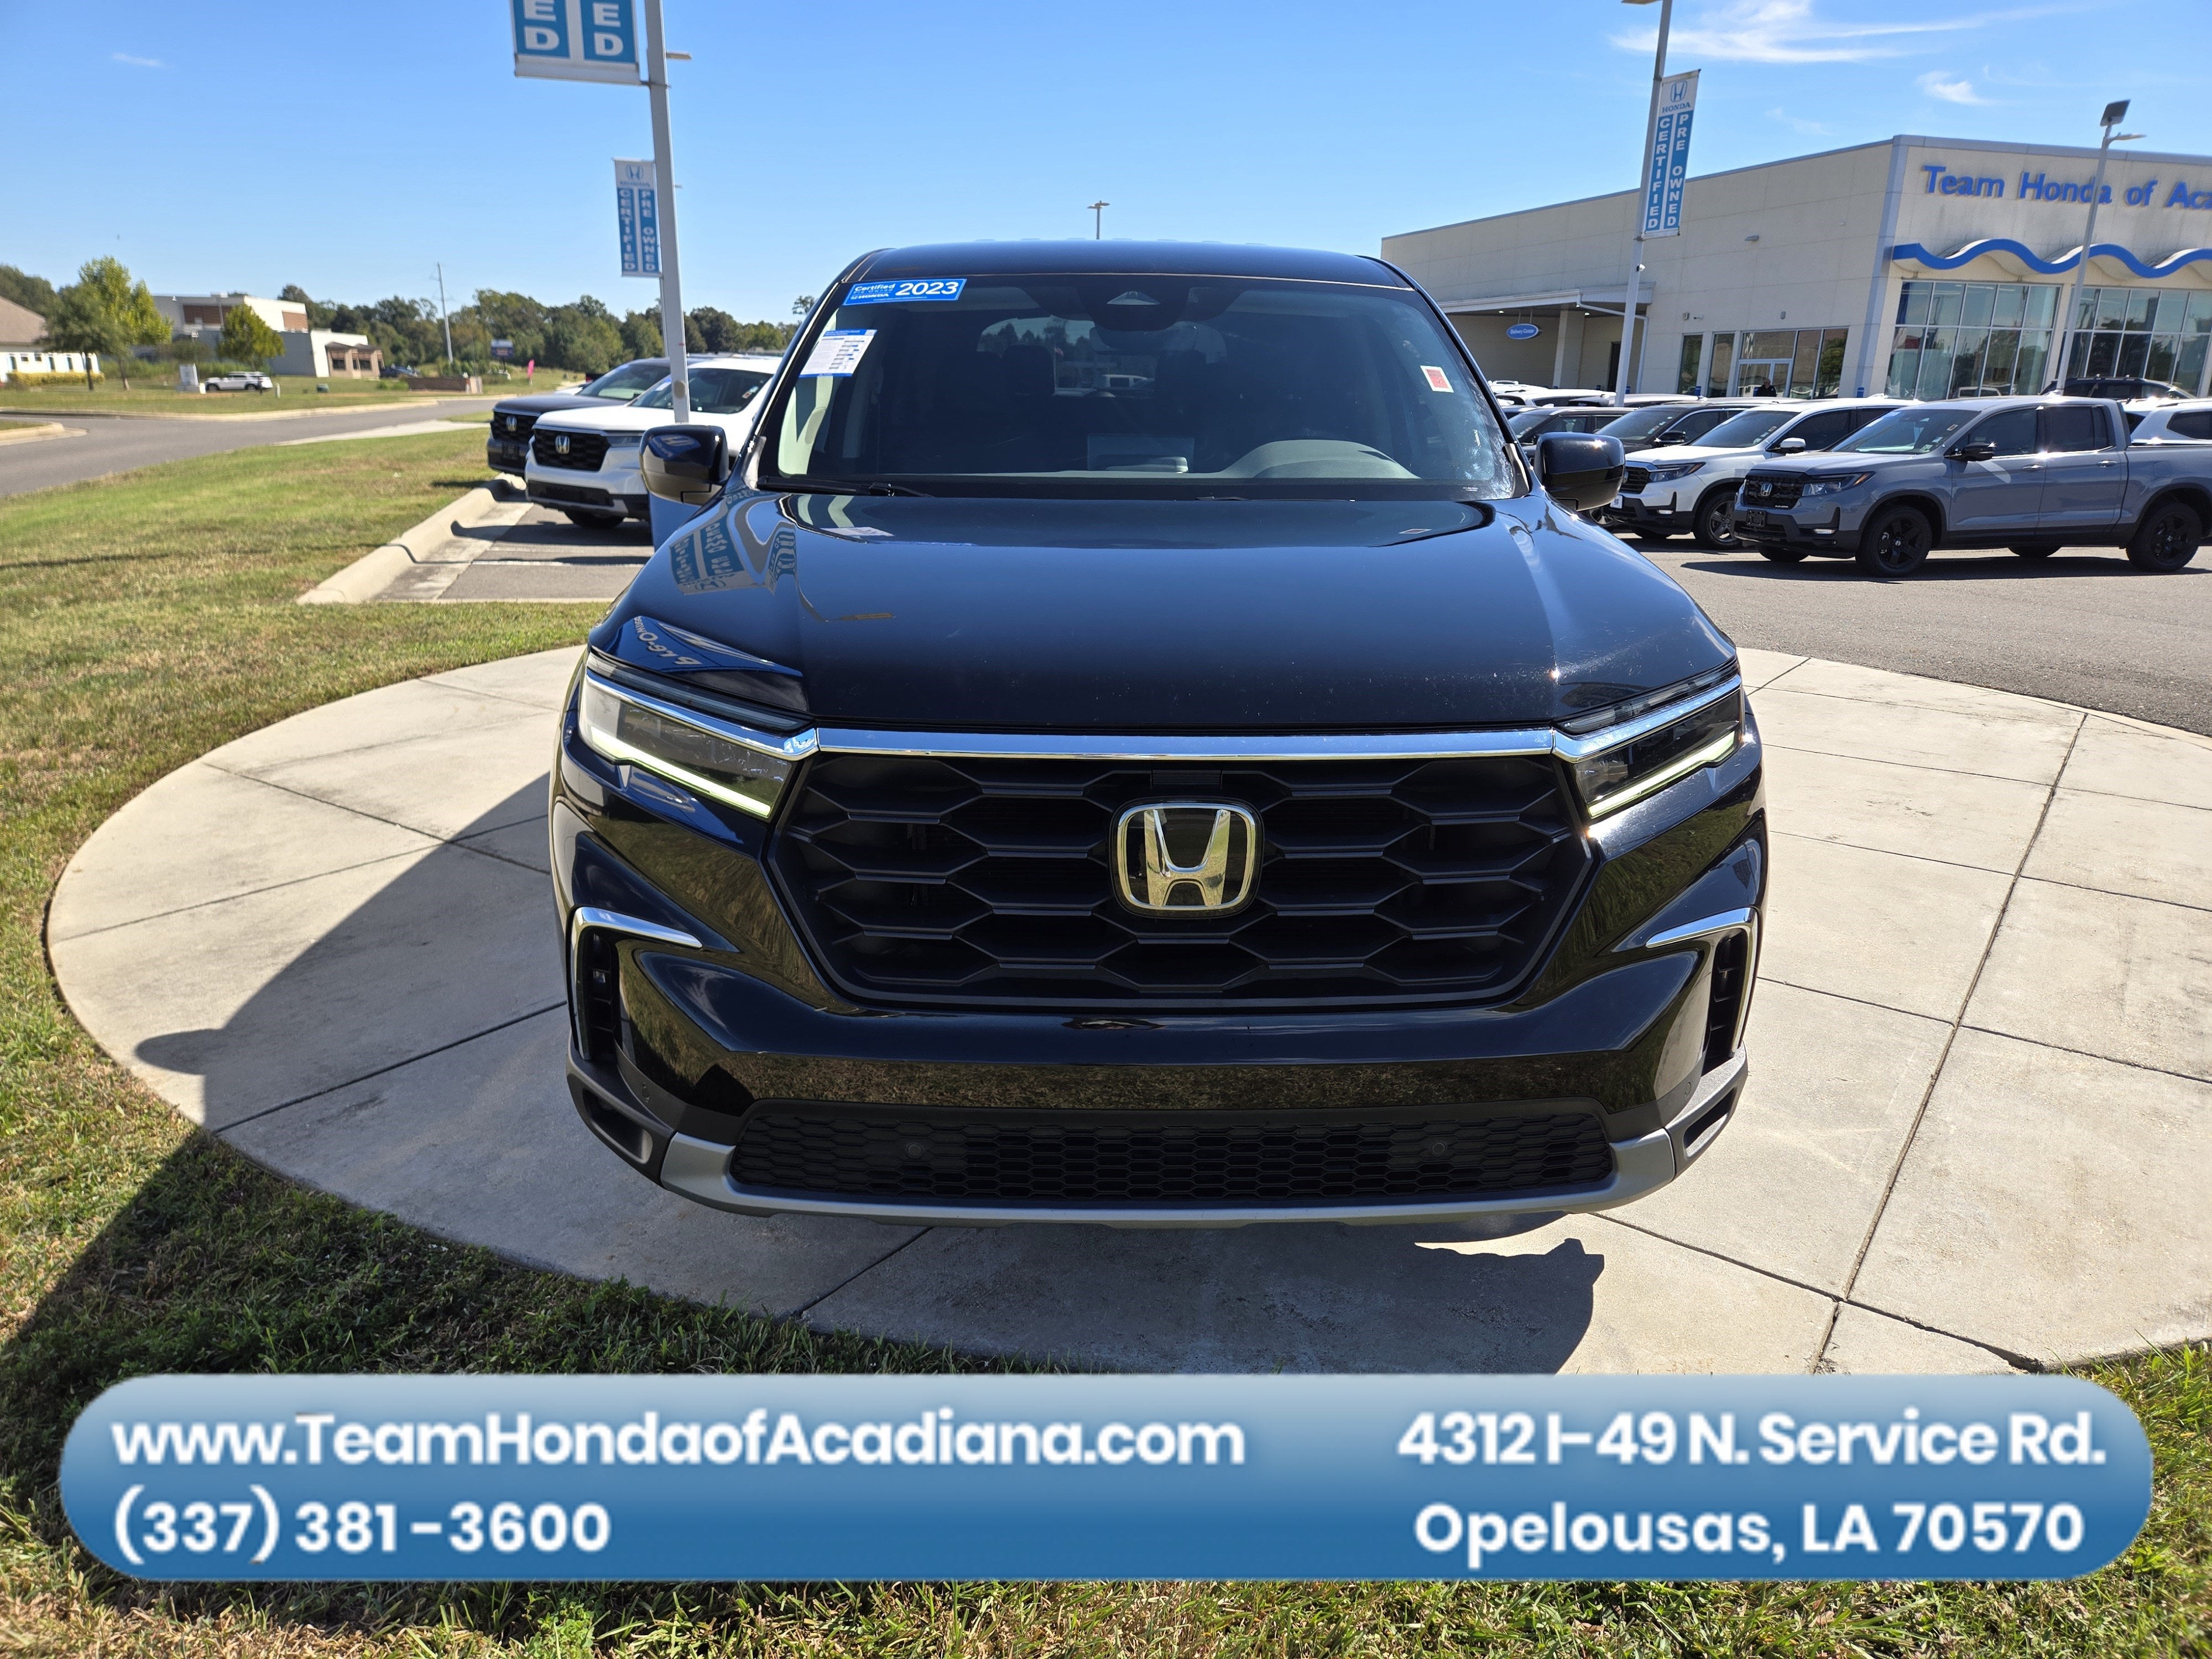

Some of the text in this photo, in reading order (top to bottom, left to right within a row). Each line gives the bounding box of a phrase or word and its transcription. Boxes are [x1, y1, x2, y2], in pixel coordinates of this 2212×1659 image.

[1662, 101, 1691, 113] HONDA
[1648, 117, 1671, 229] CERTIFIED
[1667, 113, 1689, 227] PRE OWNED
[1922, 165, 2005, 198] Team
[2018, 171, 2112, 204] Honda
[2126, 179, 2158, 206] of
[854, 281, 959, 296] Certified 2023
